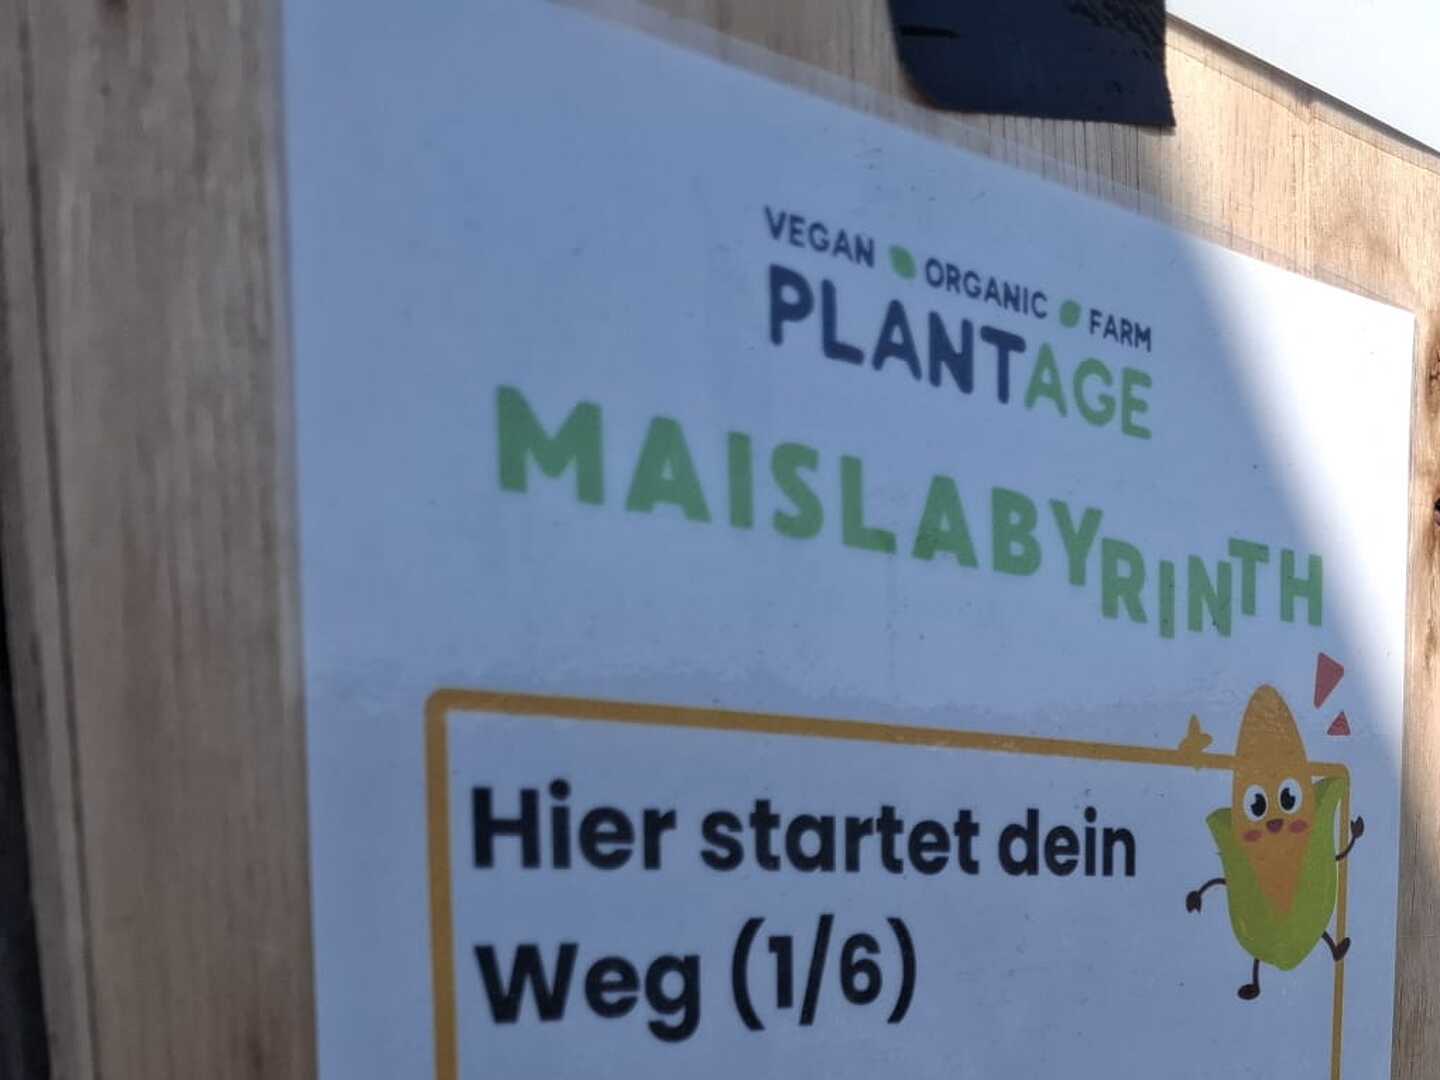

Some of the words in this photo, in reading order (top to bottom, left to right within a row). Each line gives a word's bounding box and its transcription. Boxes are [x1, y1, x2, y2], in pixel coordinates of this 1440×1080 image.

[763, 206, 876, 269] VEGAN
[925, 257, 1049, 320] ORGANIC
[1089, 308, 1153, 352] FARM
[767, 263, 1153, 440] PLANTAGE
[496, 385, 1325, 640] MAISLABYRINTH
[471, 779, 677, 870] Hier
[700, 799, 979, 876] startet
[998, 806, 1137, 878] dein
[475, 942, 701, 1043] Weg
[731, 913, 917, 1031] (1/6)
